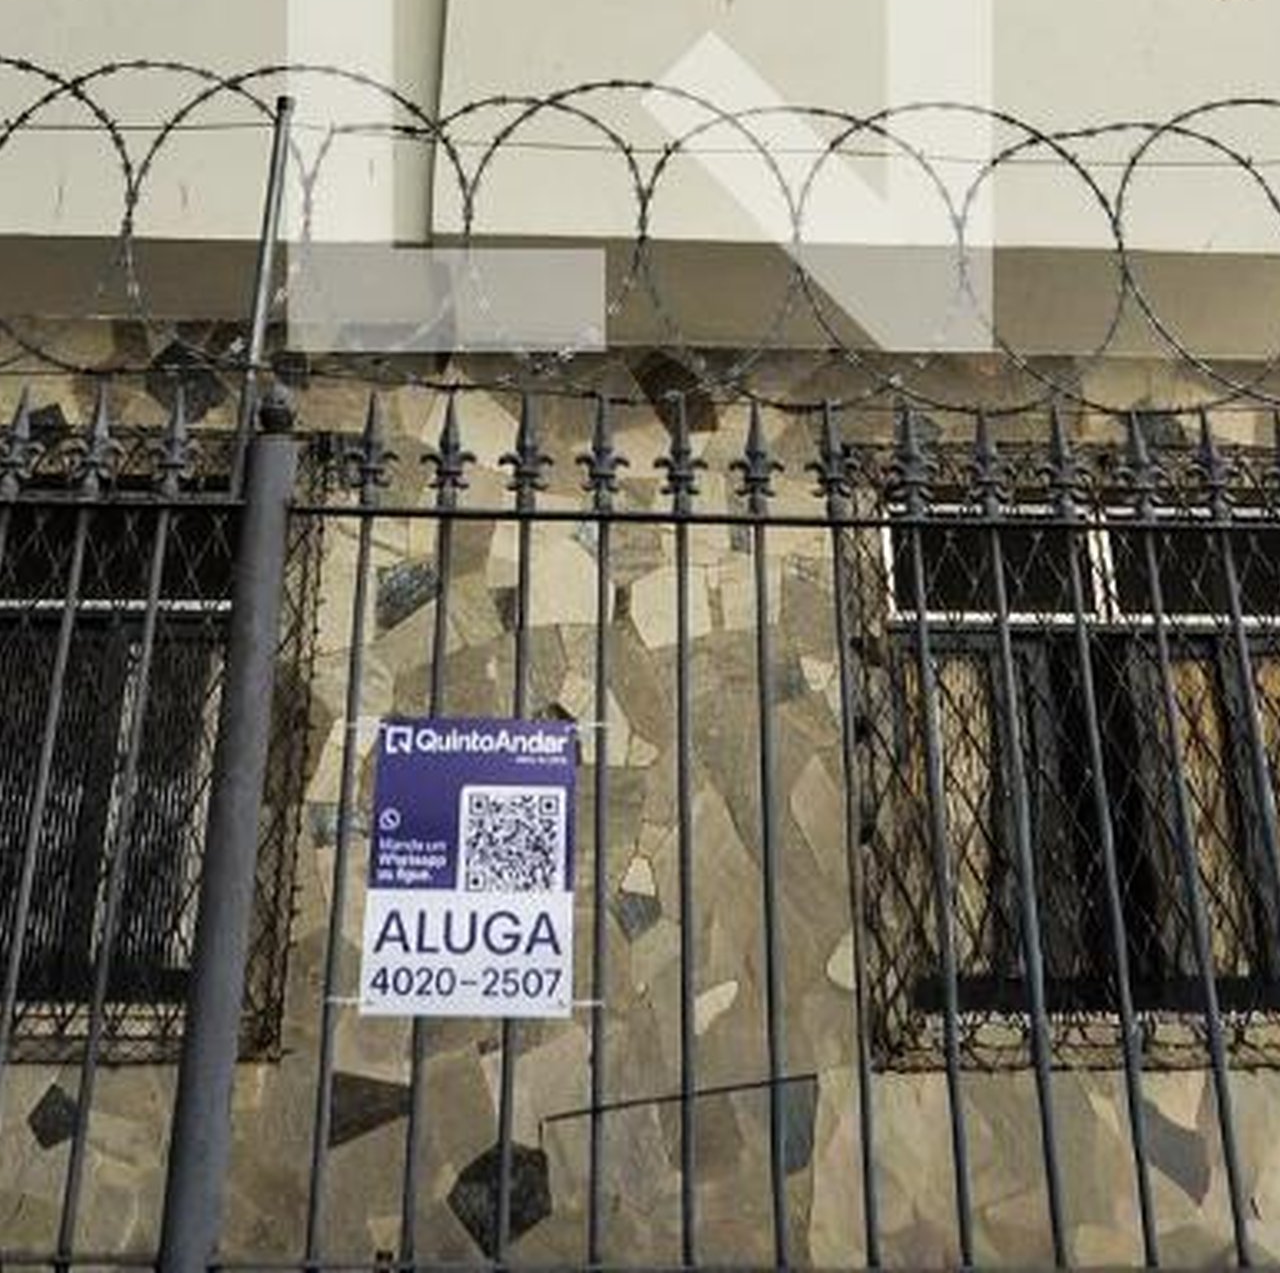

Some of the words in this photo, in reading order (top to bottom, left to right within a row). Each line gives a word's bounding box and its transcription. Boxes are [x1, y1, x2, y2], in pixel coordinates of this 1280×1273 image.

[416, 729, 567, 754] QuintoAndar
[373, 909, 562, 956] ALUGA
[370, 966, 563, 999] 4020-2507
